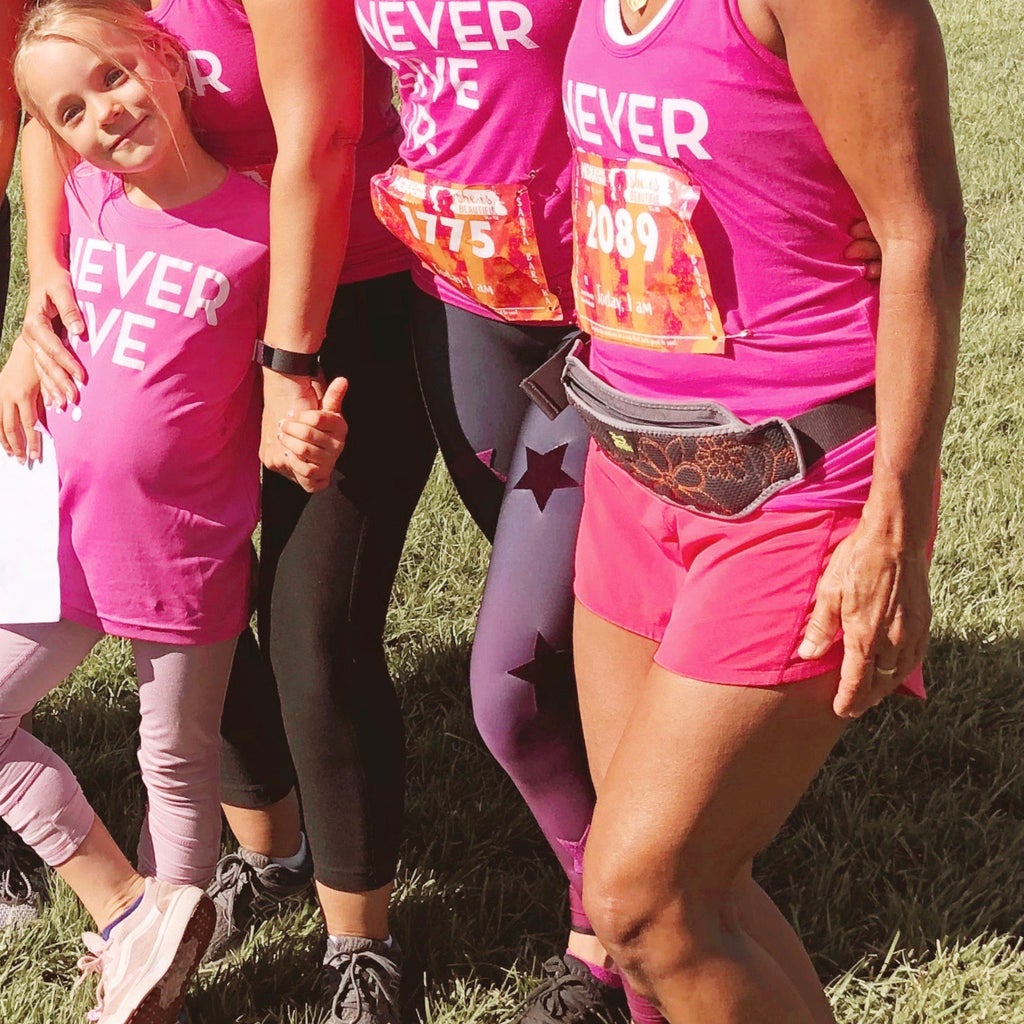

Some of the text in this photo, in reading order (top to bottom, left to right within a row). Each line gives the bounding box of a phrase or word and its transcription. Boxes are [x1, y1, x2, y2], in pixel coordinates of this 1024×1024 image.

[356, 0, 541, 52] NEVER
[398, 204, 496, 259] 1775
[586, 200, 659, 262] 2089
